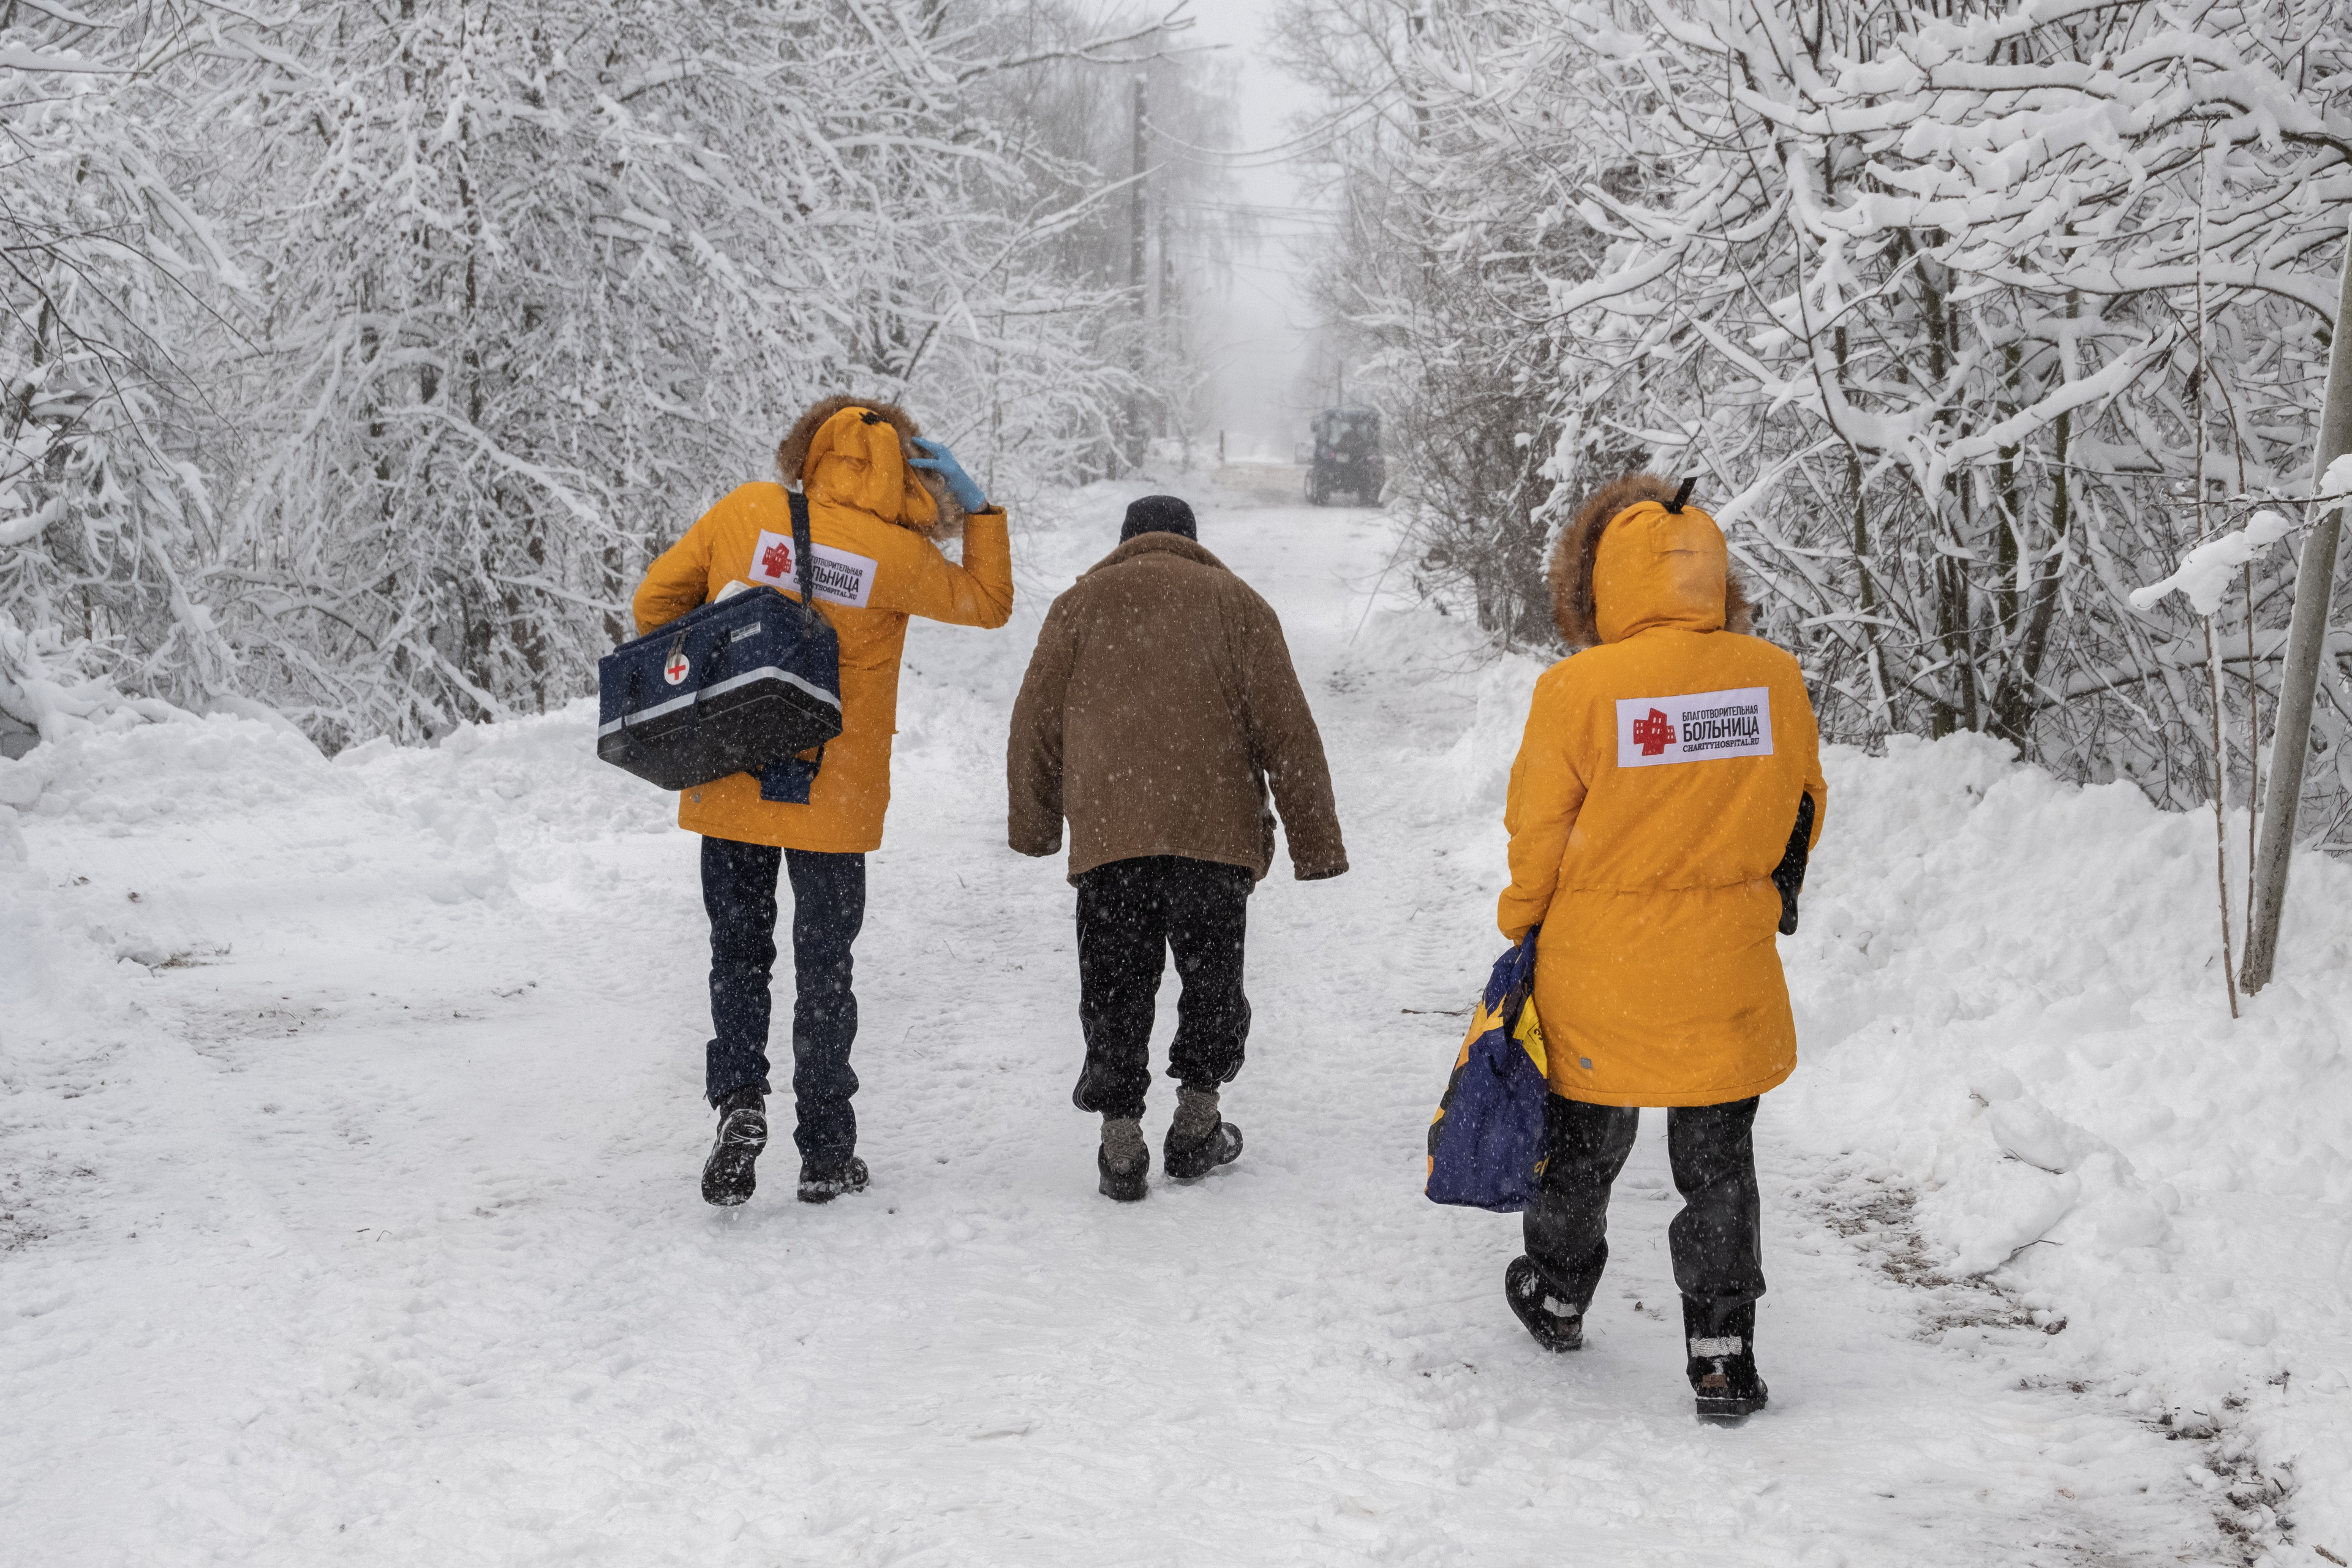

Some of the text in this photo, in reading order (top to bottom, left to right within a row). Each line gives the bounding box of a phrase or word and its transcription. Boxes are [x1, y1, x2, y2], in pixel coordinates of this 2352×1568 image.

[812, 556, 863, 577] ГОТВОРИТЕЛЬНАЯ
[793, 576, 858, 600] CTYHOSPITAL.RU
[812, 566, 859, 593] ЛЬНИЦА
[1683, 704, 1758, 722] БЛАГОТВОРИТЕЛЬНАЯ
[1683, 715, 1760, 742] БОЛЬНИЦА
[1683, 737, 1760, 753] CHARITYHOSPITAL.RU
